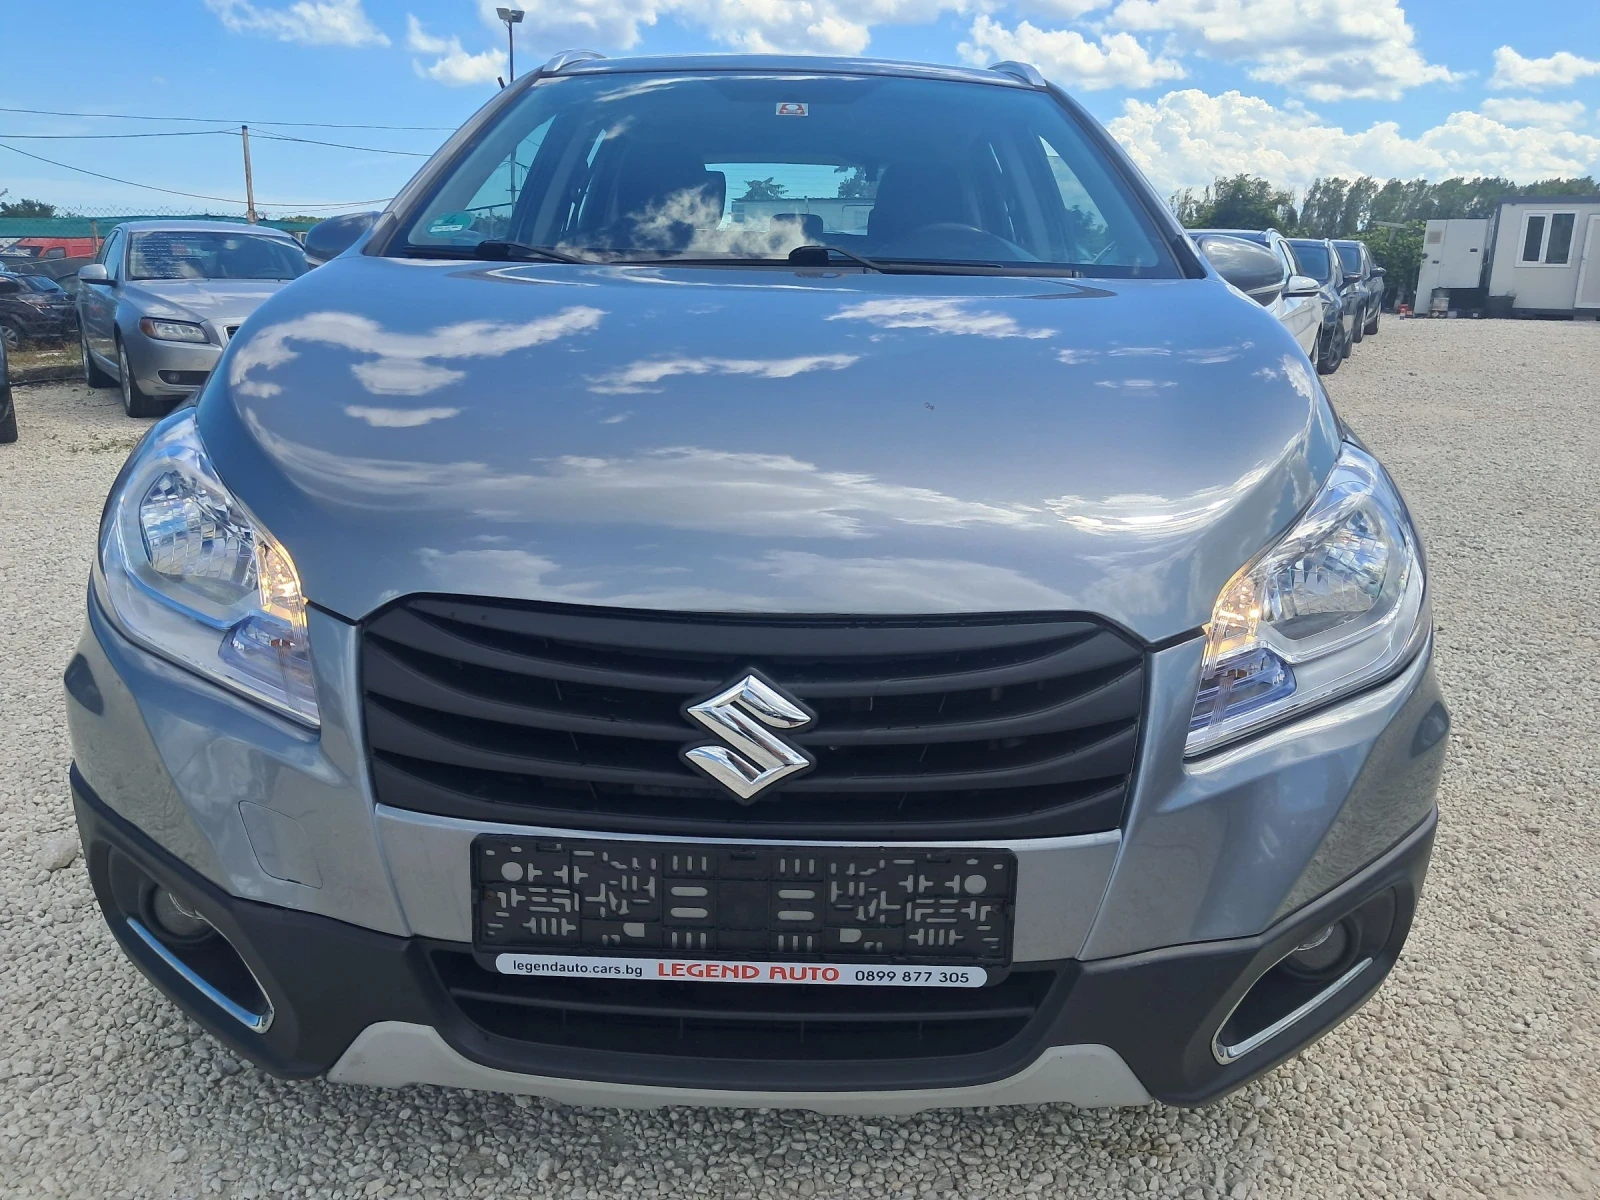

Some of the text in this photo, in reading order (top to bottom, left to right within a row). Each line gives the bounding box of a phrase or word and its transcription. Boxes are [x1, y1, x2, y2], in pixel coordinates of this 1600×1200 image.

[513, 960, 969, 983] legendauto.cars.bg LEGEND AUTO 0899 877 305
